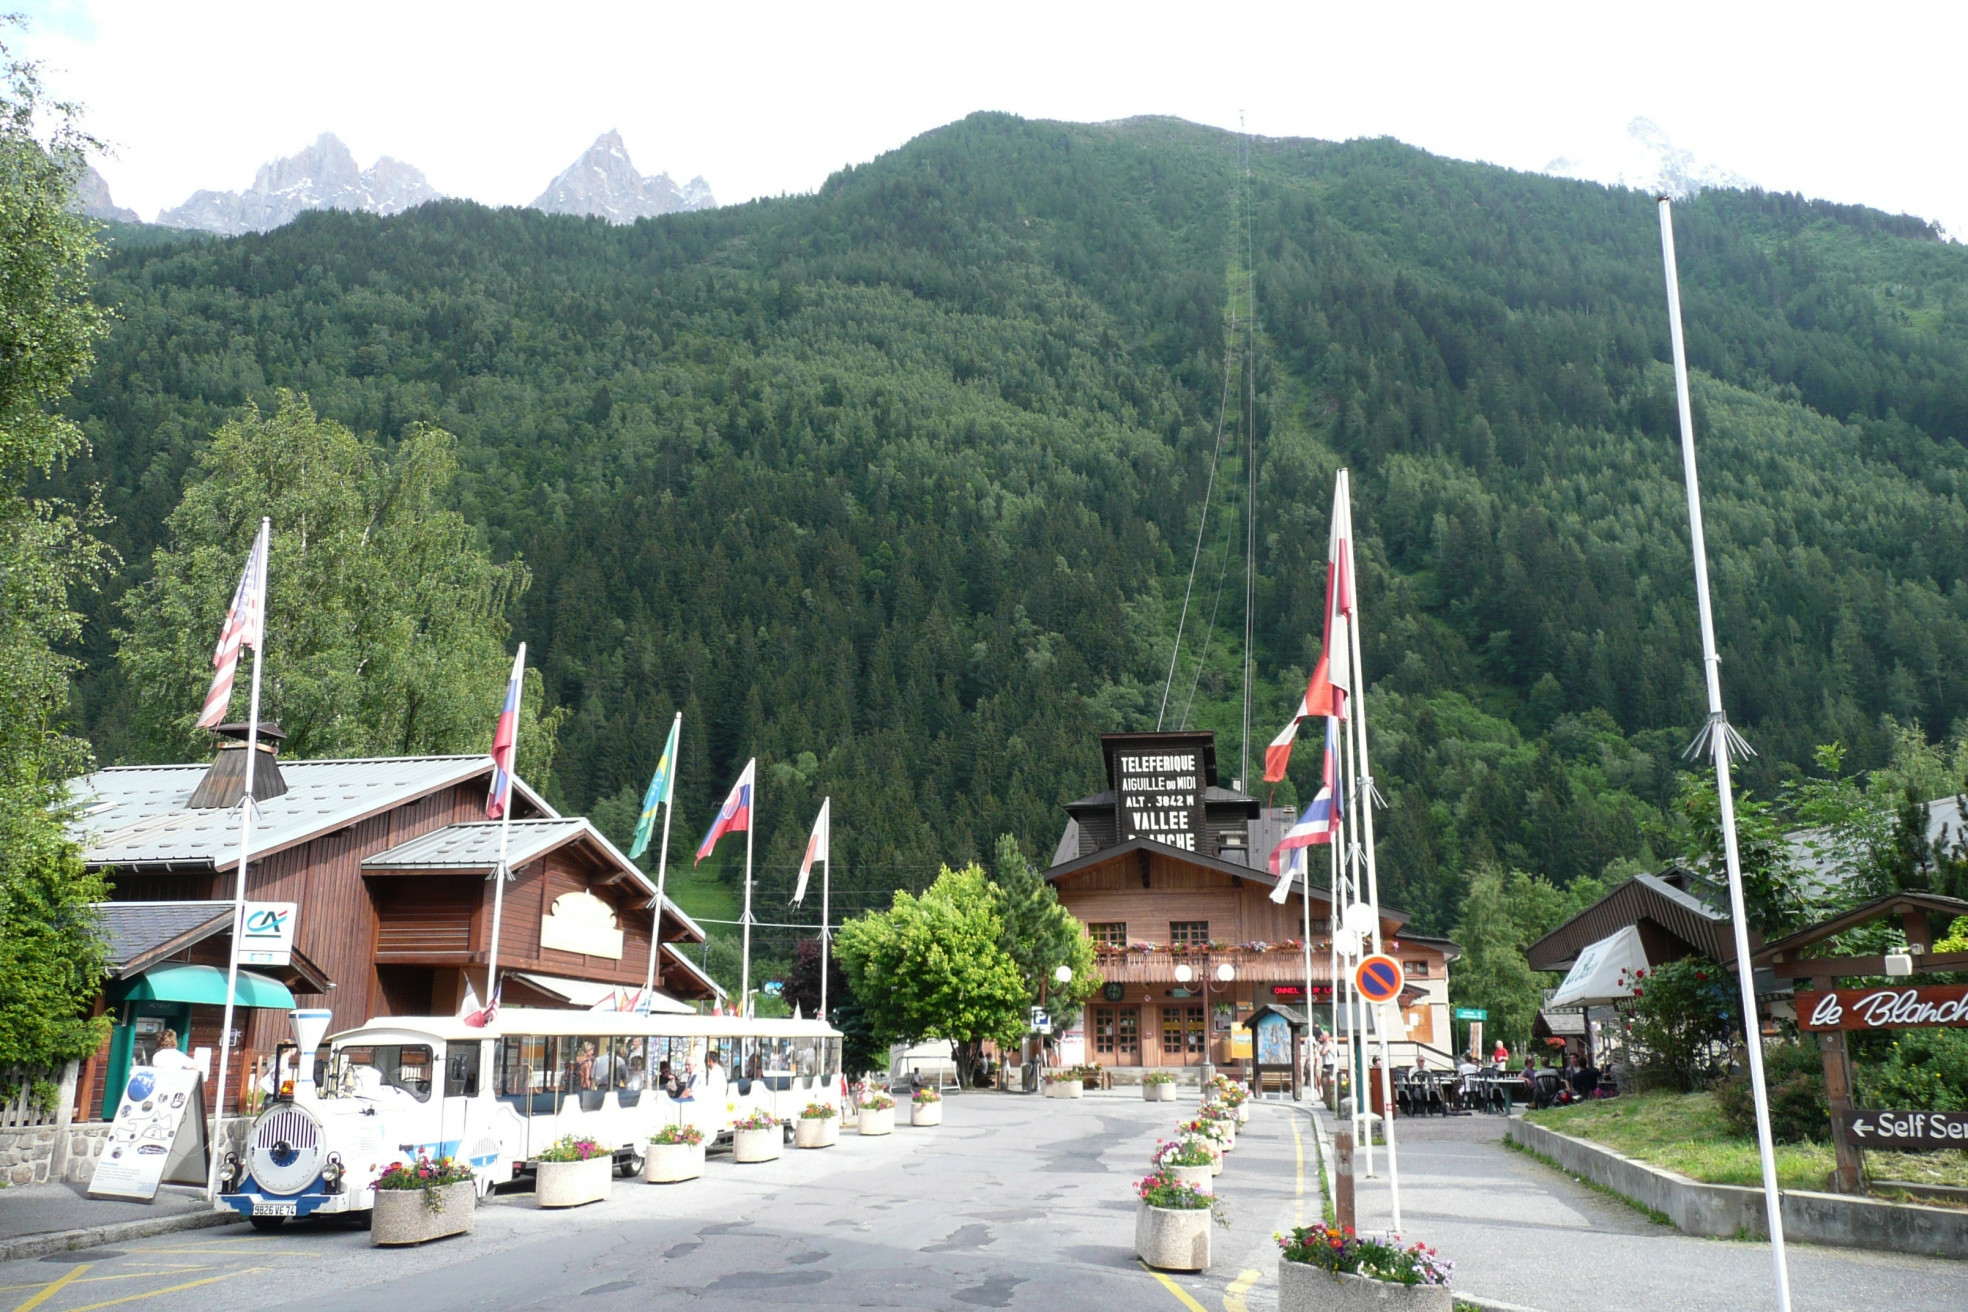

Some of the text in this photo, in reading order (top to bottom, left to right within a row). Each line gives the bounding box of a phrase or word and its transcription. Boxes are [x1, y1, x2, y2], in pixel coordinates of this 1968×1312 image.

[1121, 755, 1195, 773] TELEFERIQUE
[1123, 776, 1196, 791] AIGUILLE DU MIDI
[1156, 795, 1184, 806] 3842
[1186, 795, 1194, 806] M
[1133, 811, 1188, 830] VALLEE
[1035, 1010, 1047, 1024] P
[1877, 1113, 1926, 1138] Self
[254, 1206, 274, 1215] 9826
[286, 1206, 295, 1215] 74
